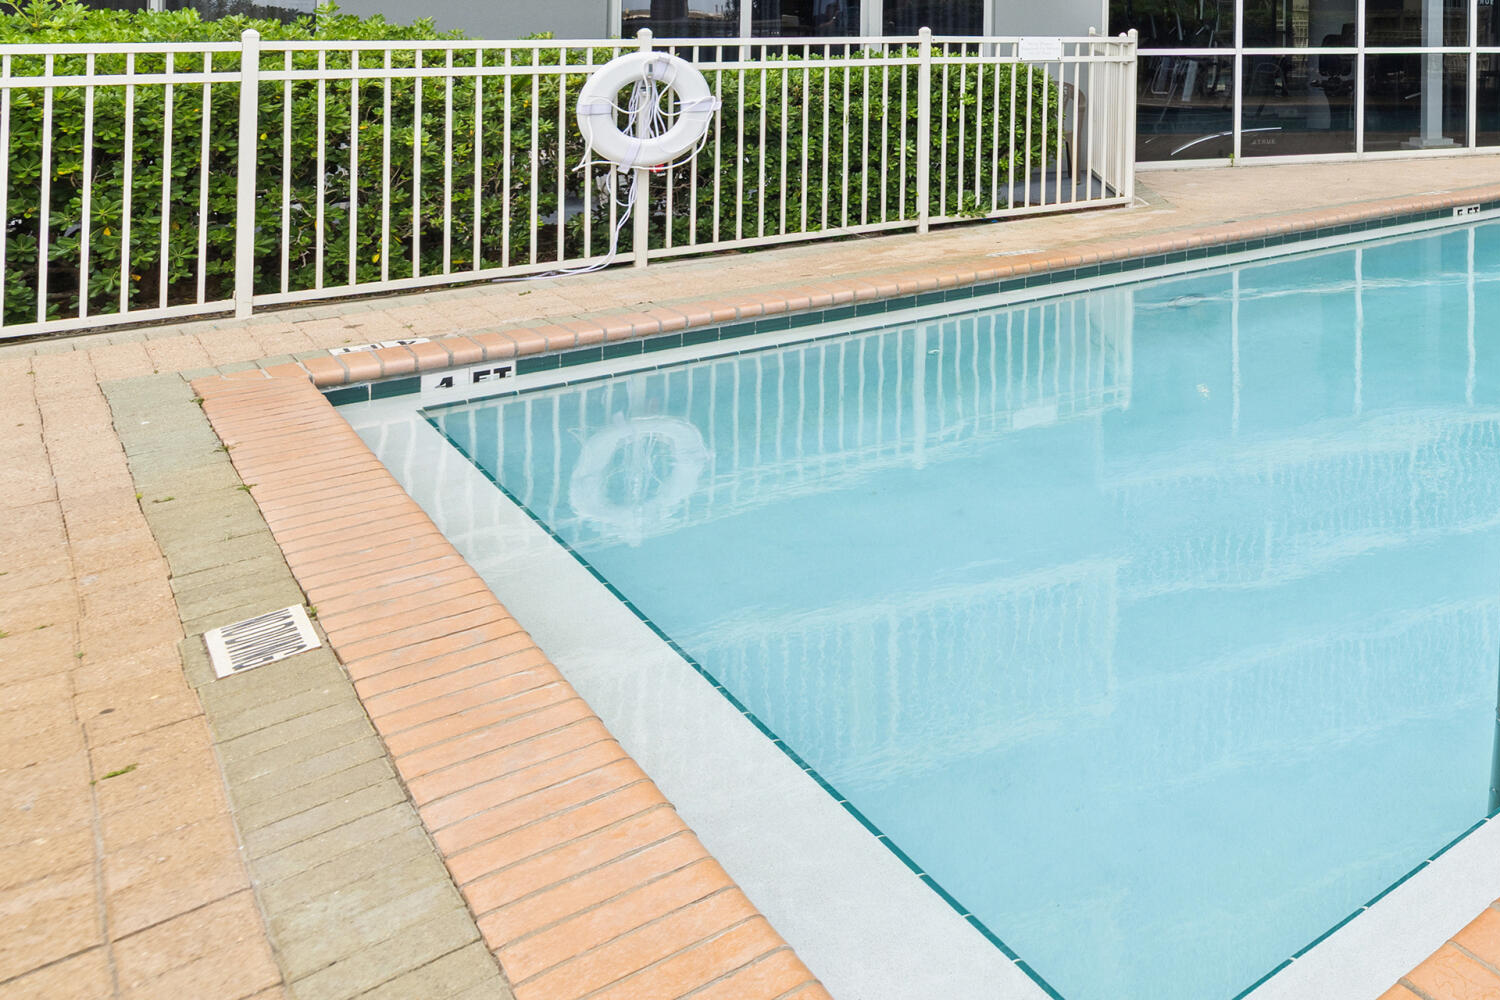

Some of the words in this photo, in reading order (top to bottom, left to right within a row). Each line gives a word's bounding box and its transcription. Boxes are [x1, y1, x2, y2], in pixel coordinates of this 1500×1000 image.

[435, 376, 456, 388] 4
[473, 366, 512, 384] FT
[220, 608, 293, 637] NO
[224, 621, 307, 671] DIVING
